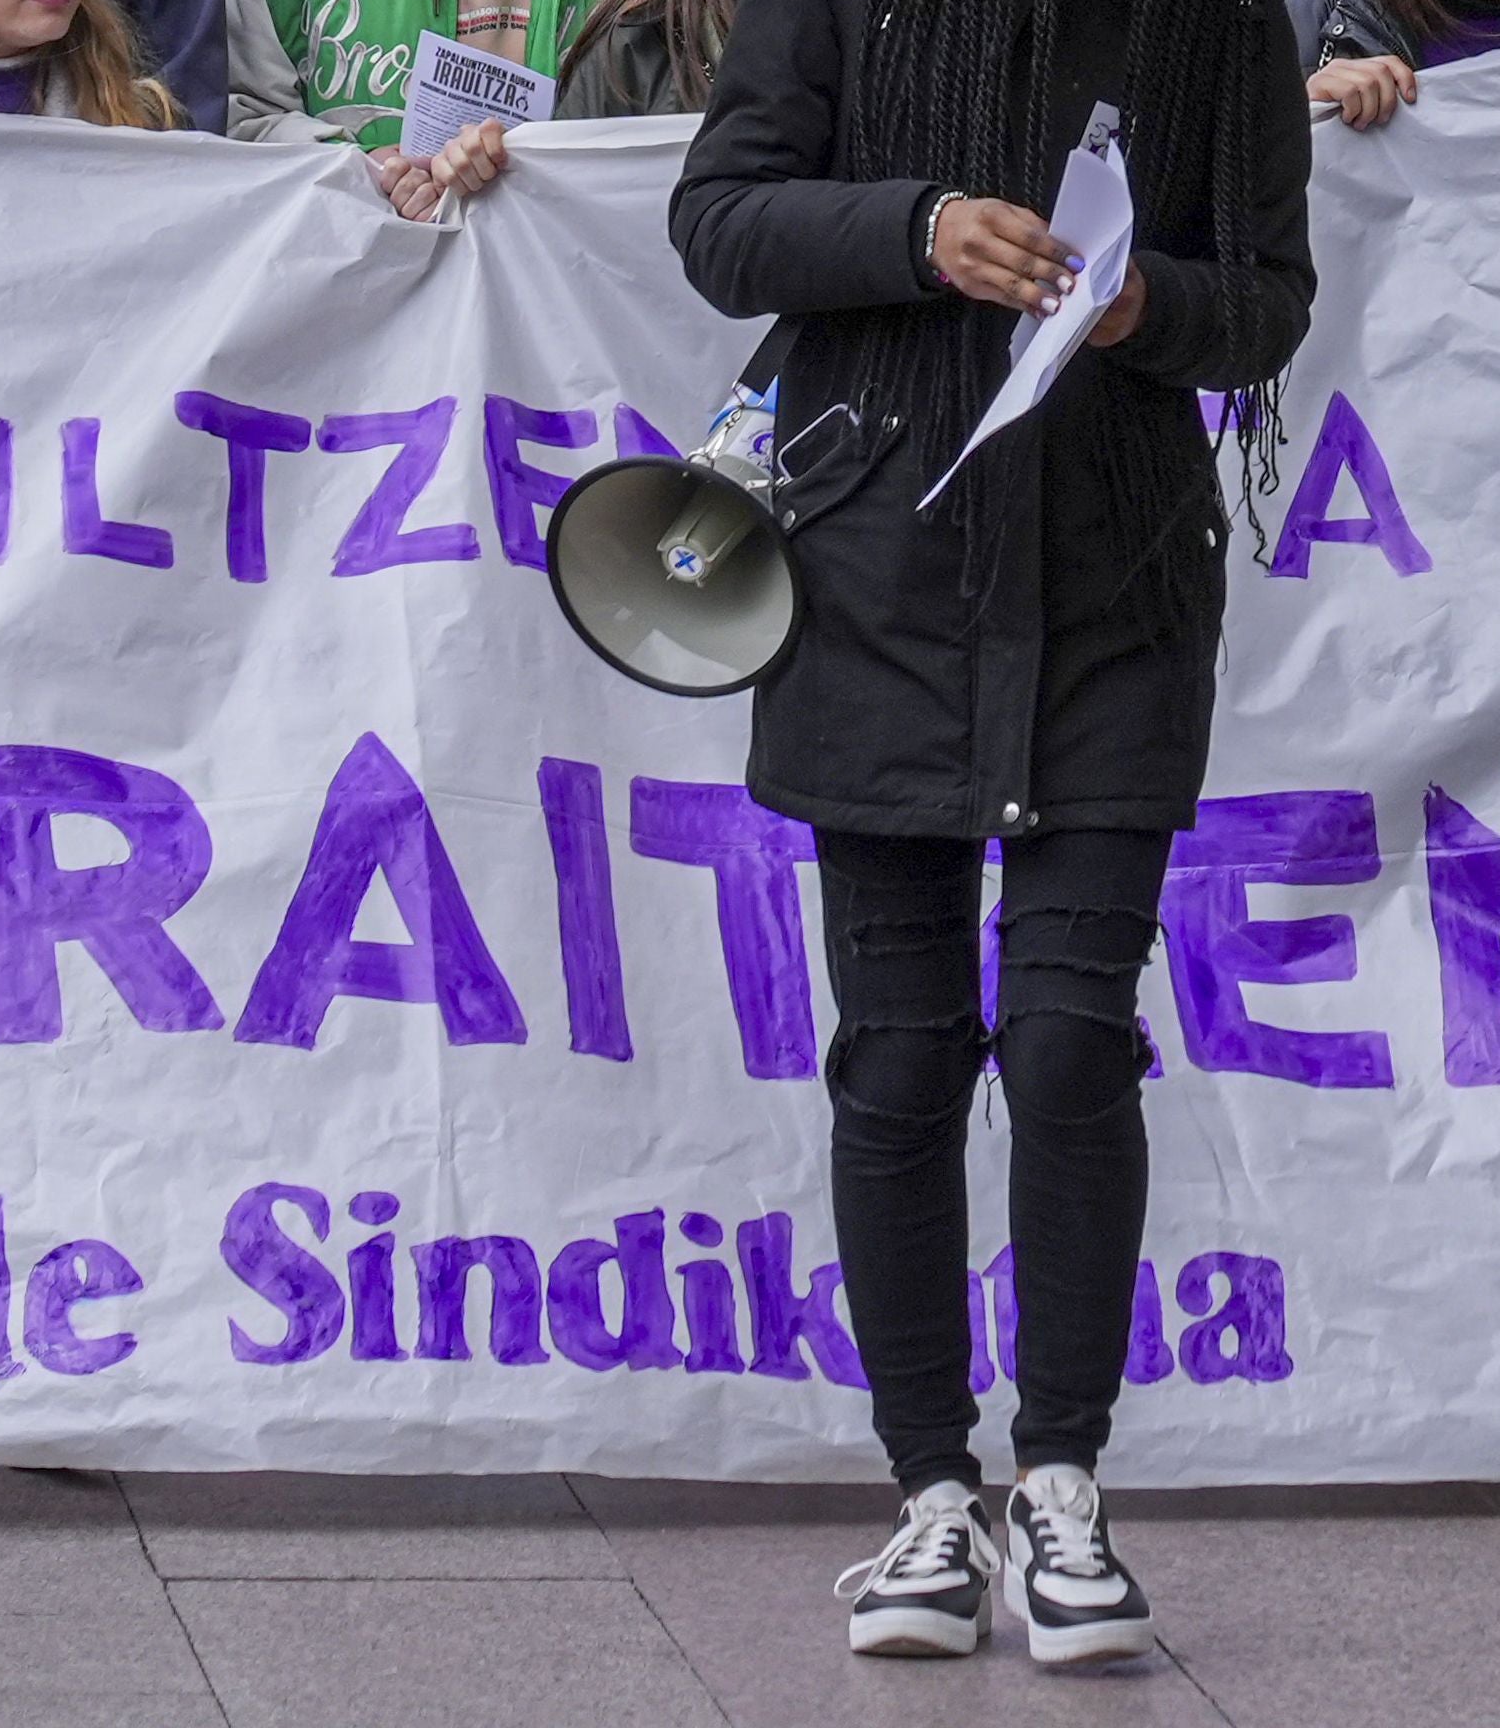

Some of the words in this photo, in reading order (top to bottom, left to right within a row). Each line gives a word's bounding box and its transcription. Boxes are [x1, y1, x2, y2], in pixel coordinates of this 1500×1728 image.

[433, 59, 517, 107] IRAULTZA
[435, 46, 508, 78] ZAPALKUNTZAREN
[509, 73, 535, 92] AURKA
